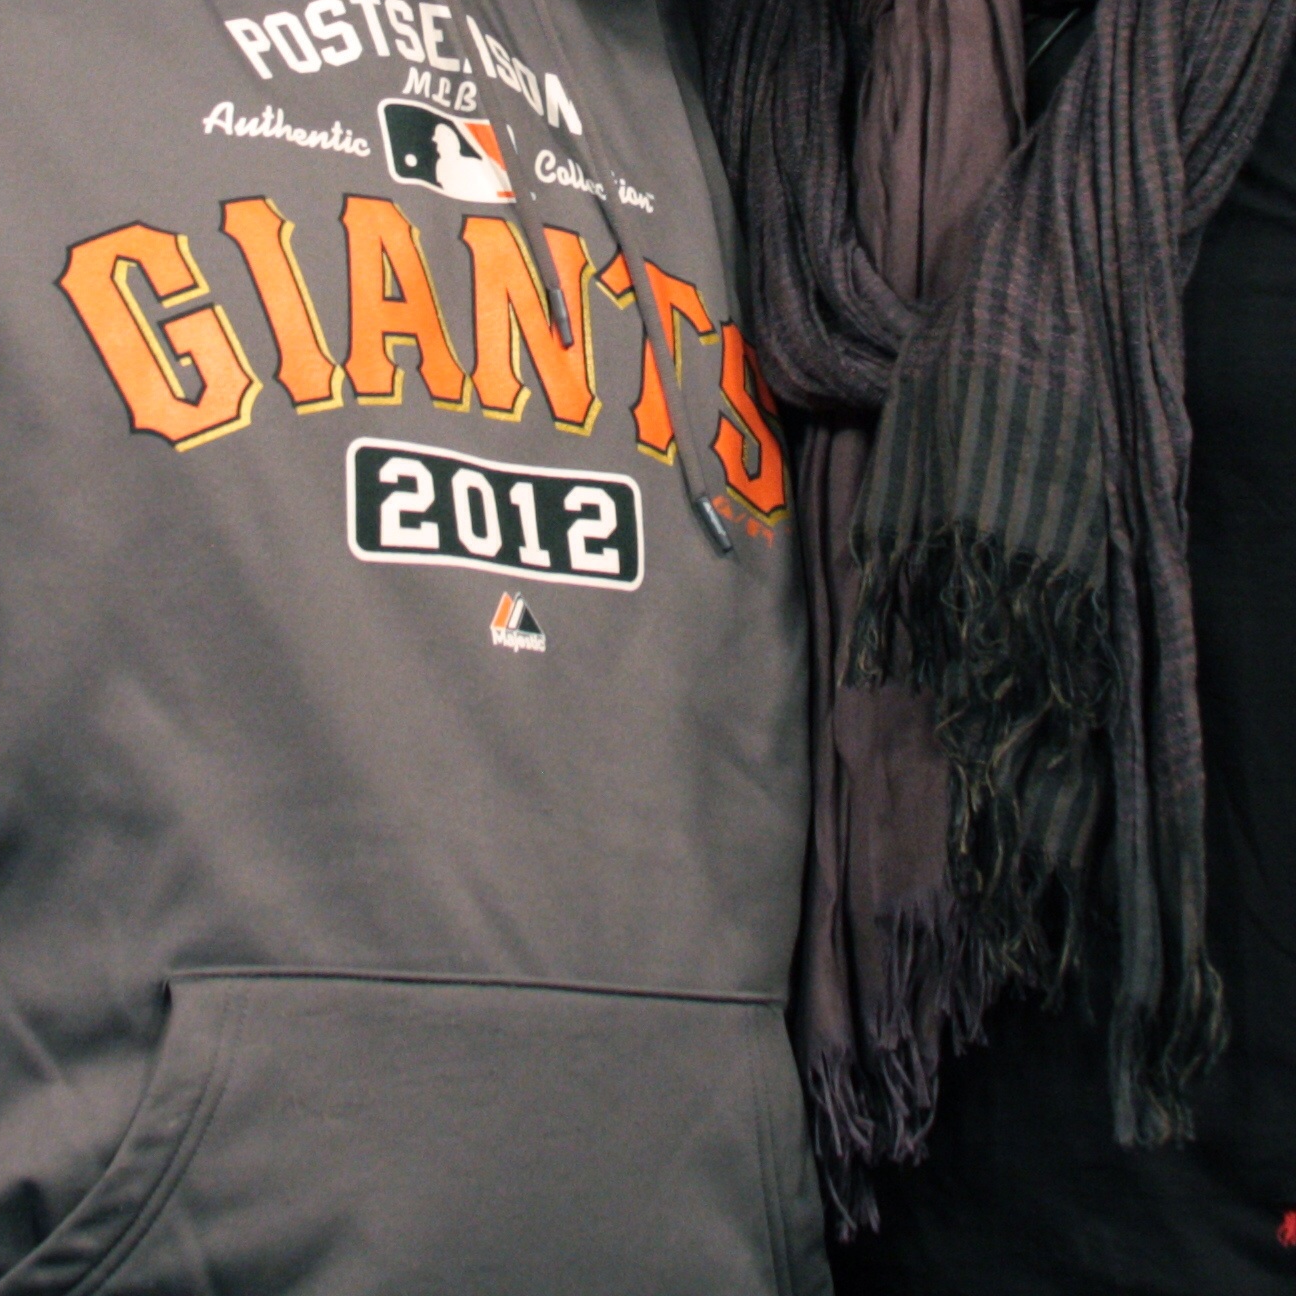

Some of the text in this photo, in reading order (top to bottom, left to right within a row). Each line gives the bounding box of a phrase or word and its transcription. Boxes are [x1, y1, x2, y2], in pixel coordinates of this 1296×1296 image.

[401, 66, 478, 113] MLB
[202, 101, 655, 214] Authentic Collecion
[56, 193, 790, 528] GIANTS
[378, 456, 620, 574] 2012
